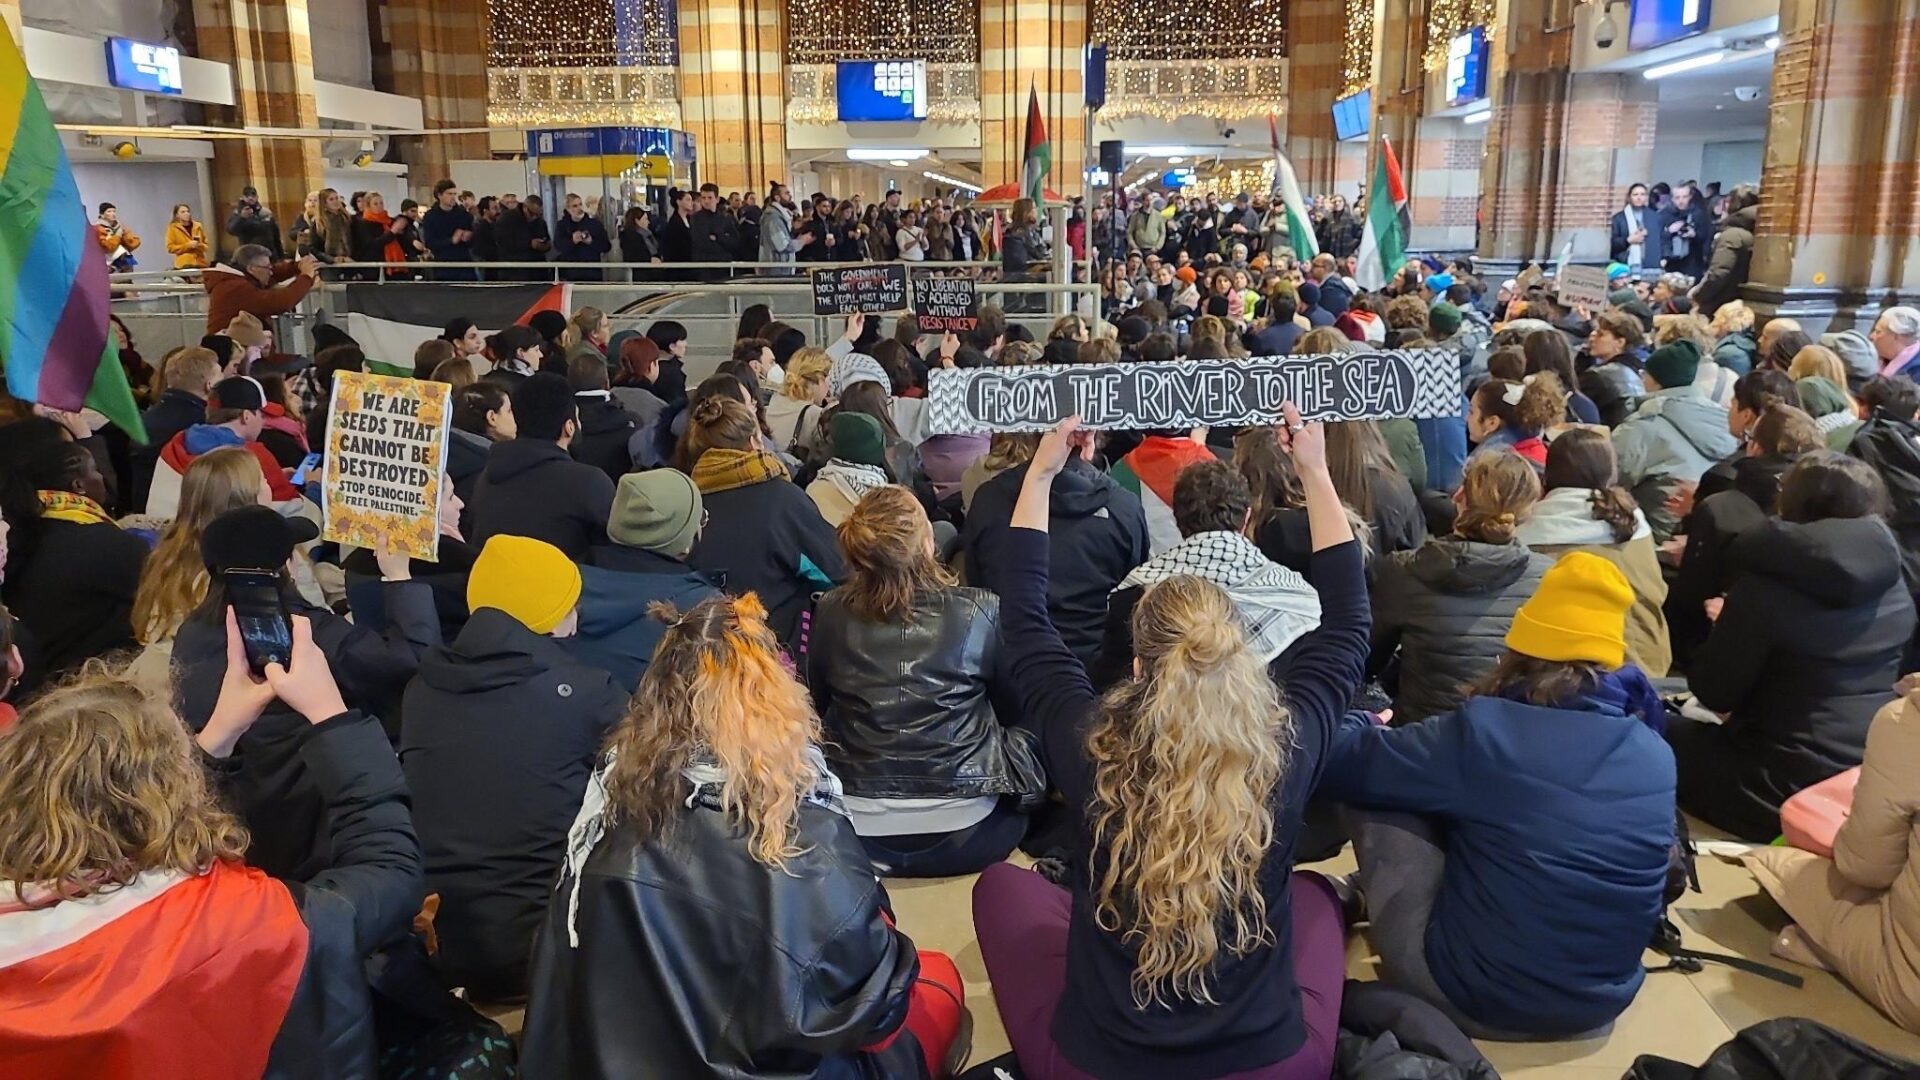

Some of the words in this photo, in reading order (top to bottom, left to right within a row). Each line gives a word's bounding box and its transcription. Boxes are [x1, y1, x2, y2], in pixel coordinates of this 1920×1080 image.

[818, 272, 835, 282] THE
[816, 284, 834, 294] DOES
[882, 279, 904, 292] WE,
[916, 280, 928, 292] NO
[930, 279, 973, 293] LIBERATION
[816, 296, 832, 305] THE
[859, 292, 876, 303] MUST
[879, 292, 901, 303] HELP
[916, 292, 926, 303] IS
[929, 292, 971, 306] ACHIEVED
[840, 304, 858, 313] EACH
[926, 304, 967, 317] WITHOUT
[919, 316, 969, 330] RESISTANCE
[978, 377, 1057, 424] FROM
[1069, 373, 1124, 423] THE
[1341, 358, 1404, 416] SEA
[362, 392, 385, 412] WE
[388, 397, 420, 418] ARE
[340, 410, 388, 435] SEEDS
[393, 419, 435, 442] THAT
[339, 434, 407, 460] CANNOT
[411, 445, 430, 465] BE
[338, 456, 429, 487] DESTROYED
[338, 480, 365, 494] STOP
[368, 484, 426, 505] GENOCIDE.
[345, 495, 368, 507] FREE
[370, 501, 418, 516] PALESTINE.
